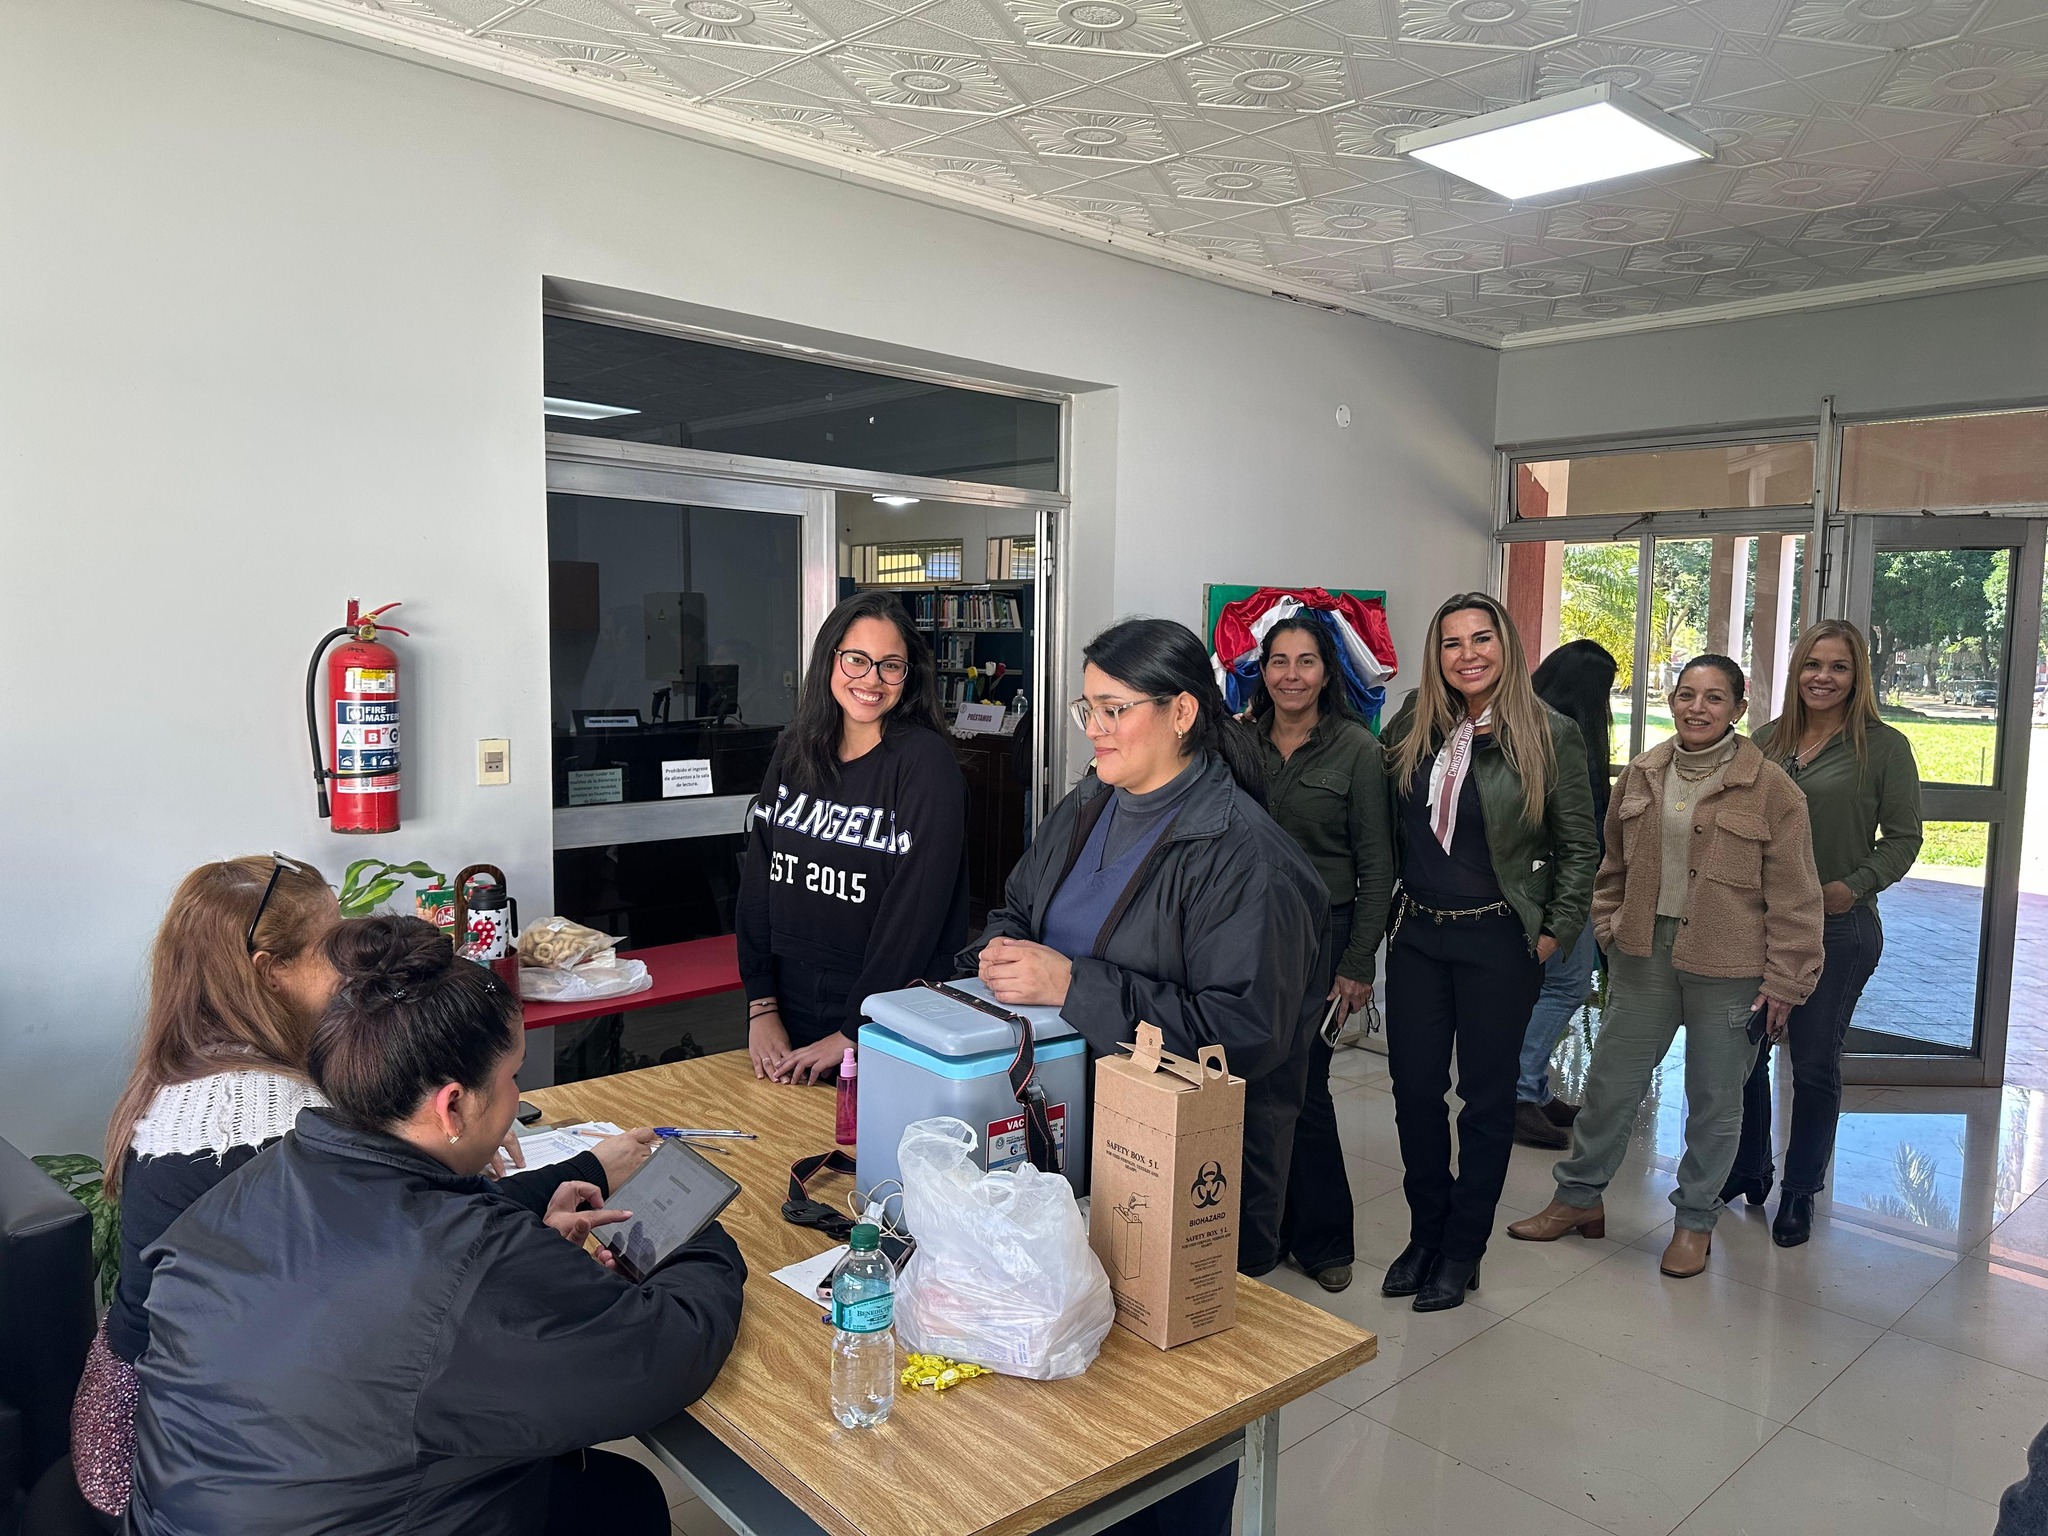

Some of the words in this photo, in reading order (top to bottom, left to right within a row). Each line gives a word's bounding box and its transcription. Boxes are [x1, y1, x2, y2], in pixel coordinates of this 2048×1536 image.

[368, 732, 378, 742] B
[1448, 740, 1468, 776] CHRISTIAN
[1461, 723, 1475, 740] DIOR
[806, 862, 867, 904] 2015
[1106, 1140, 1130, 1156] SAFETY
[1130, 1150, 1146, 1164] BOX
[1148, 1159, 1153, 1168] 5
[1154, 1161, 1160, 1170] L
[1190, 1212, 1226, 1227] BIOHAZARD
[1186, 1232, 1206, 1243] SAFETY
[1206, 1230, 1218, 1238] BOX
